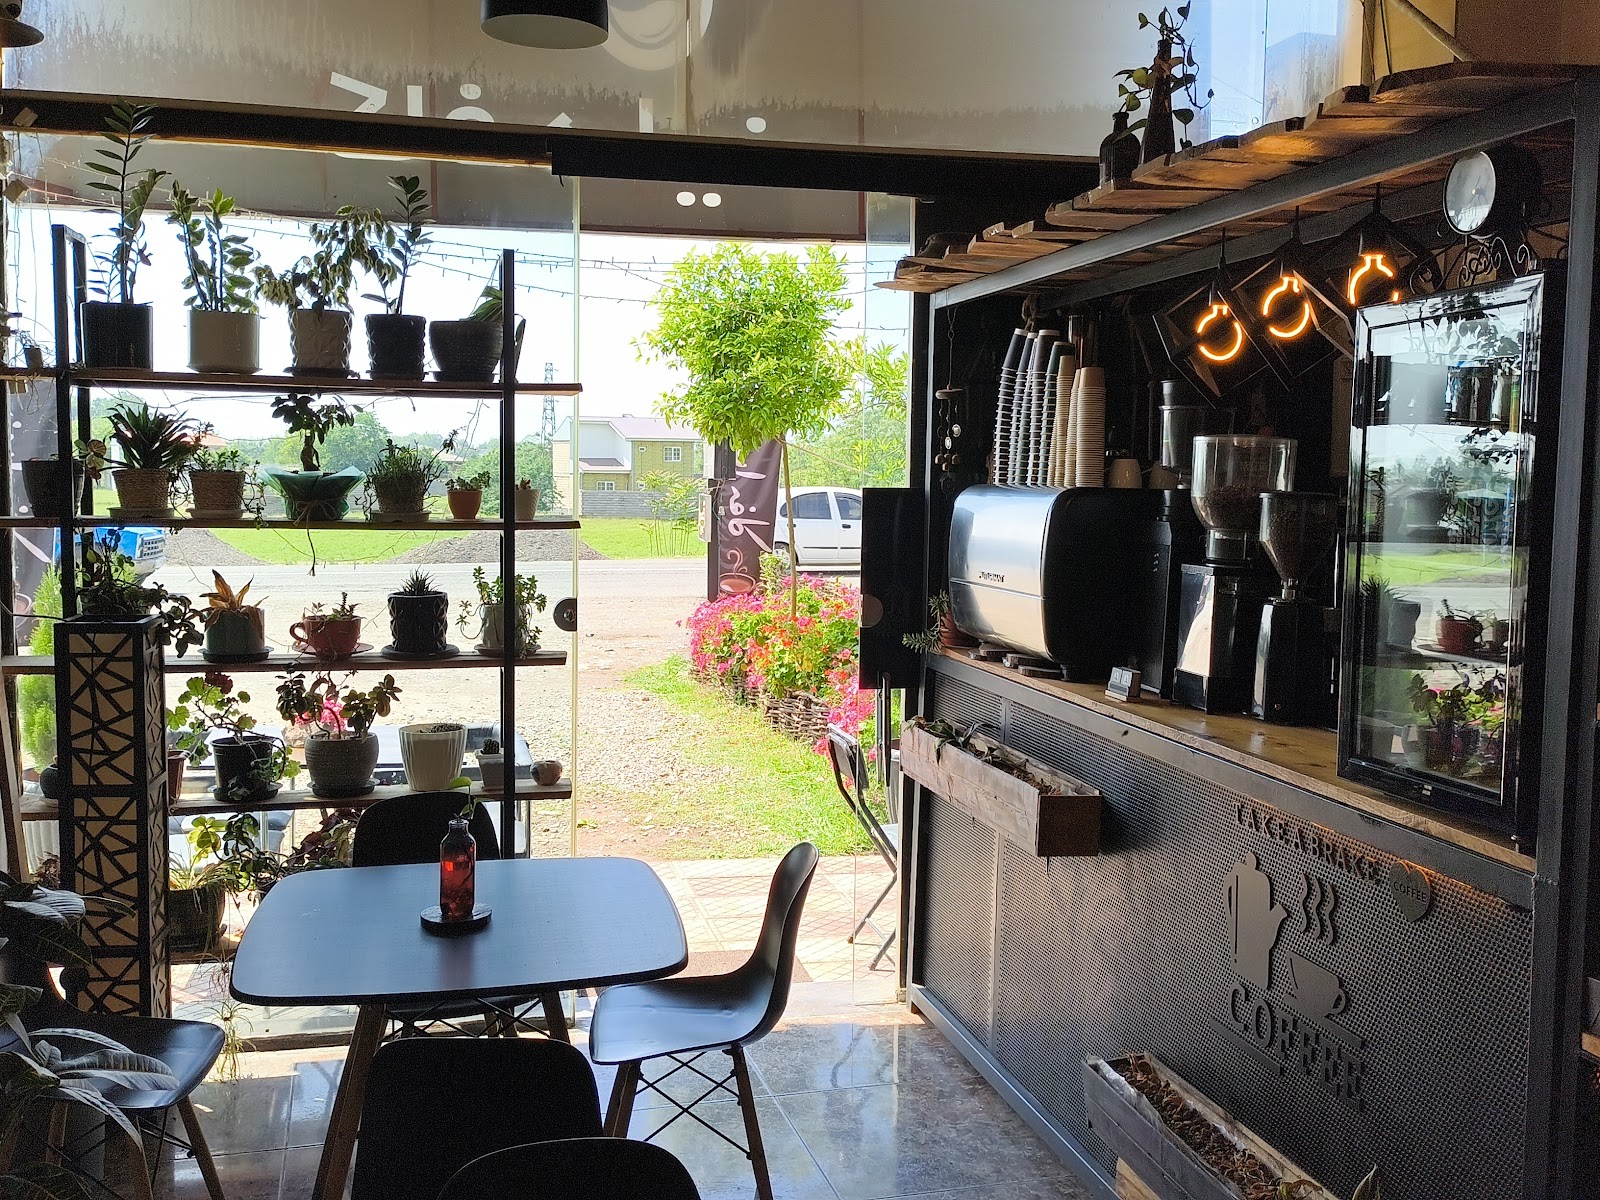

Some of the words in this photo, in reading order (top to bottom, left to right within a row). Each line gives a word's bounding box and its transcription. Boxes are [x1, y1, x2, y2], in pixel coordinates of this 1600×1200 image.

[1233, 802, 1288, 841] TAKE
[1293, 826, 1308, 851] A
[1394, 881, 1427, 903] COFFEE
[1229, 981, 1366, 1110] COFFEE
